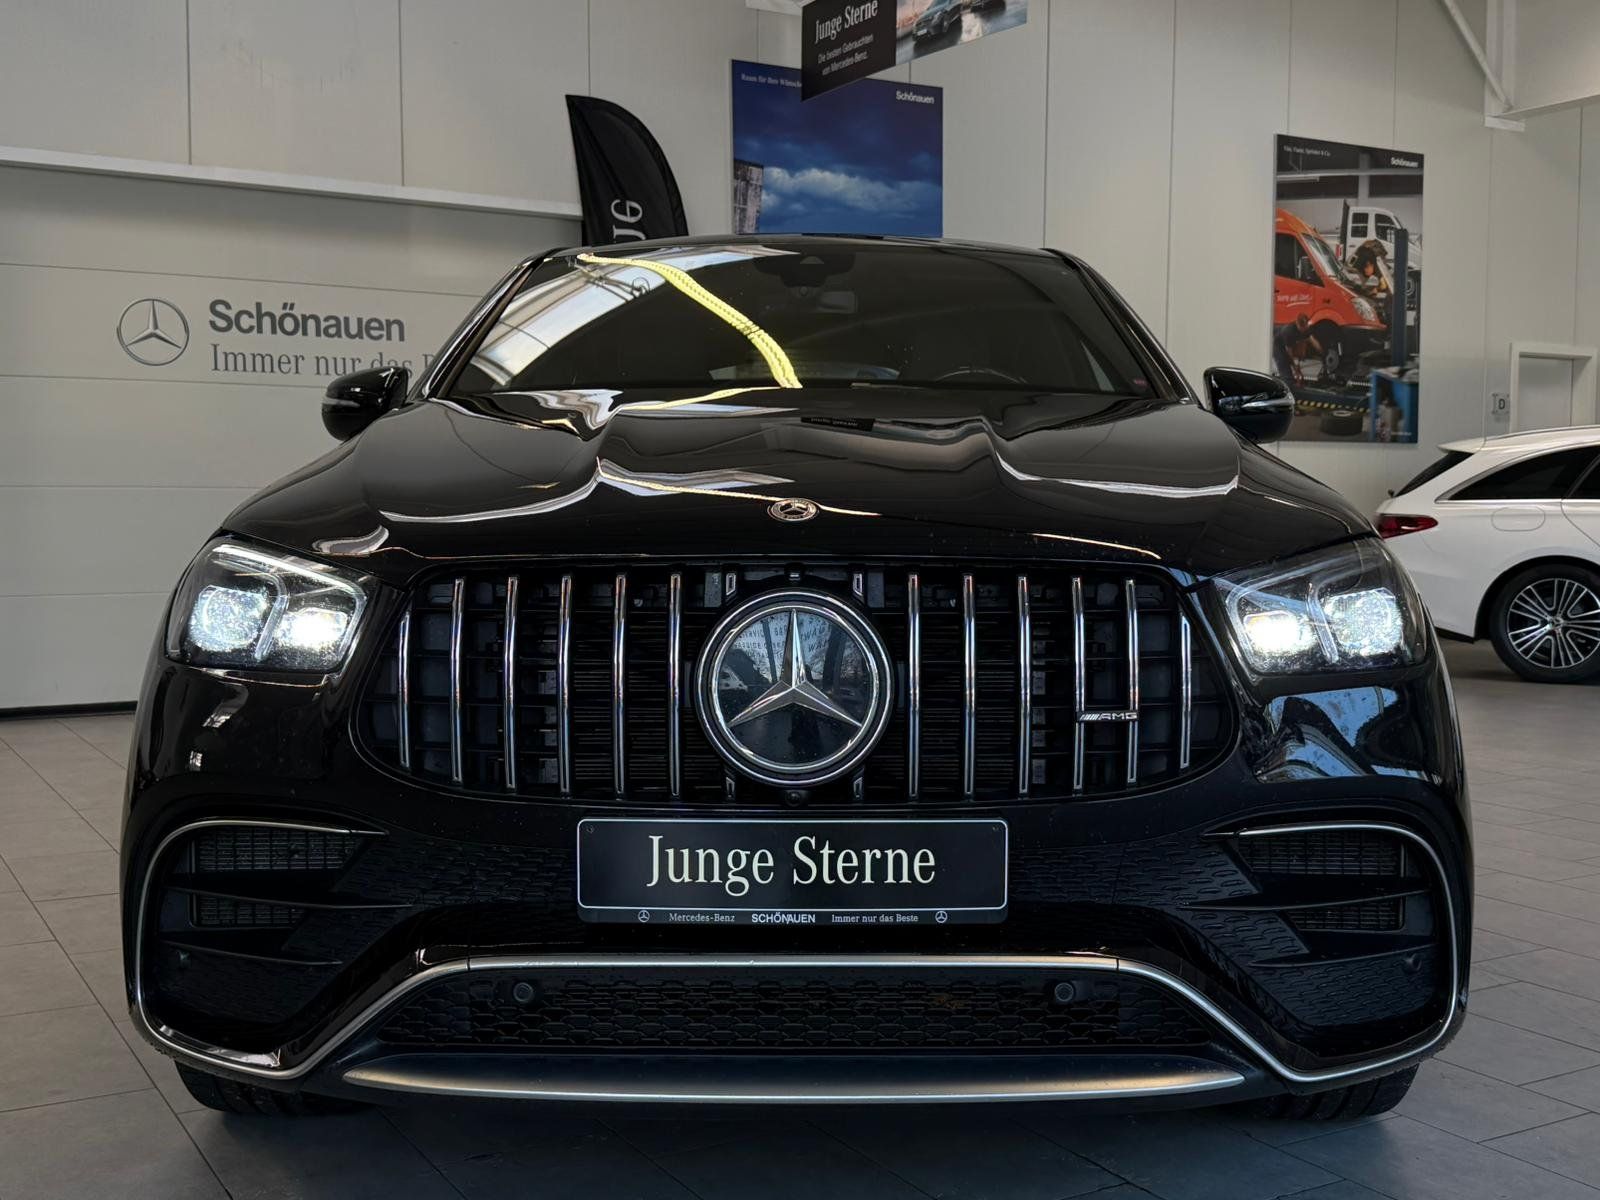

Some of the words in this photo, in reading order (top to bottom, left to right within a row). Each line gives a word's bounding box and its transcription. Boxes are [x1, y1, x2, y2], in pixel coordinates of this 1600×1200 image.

[815, 15, 842, 45] Junge
[844, 0, 879, 29] Sterne
[895, 90, 935, 104] Schönauen
[209, 299, 405, 342] Schönauen
[211, 343, 305, 374] Immer
[315, 355, 362, 377] nur
[1099, 712, 1138, 721] AMG
[646, 835, 774, 897] Junge
[793, 835, 936, 885] Sterne
[668, 912, 736, 923] Mercedes-Benz
[751, 911, 816, 924] SCHÖNAUEN
[831, 914, 860, 923] Immer
[862, 914, 878, 923] nur
[879, 913, 894, 923] das
[896, 913, 919, 923] Beste
